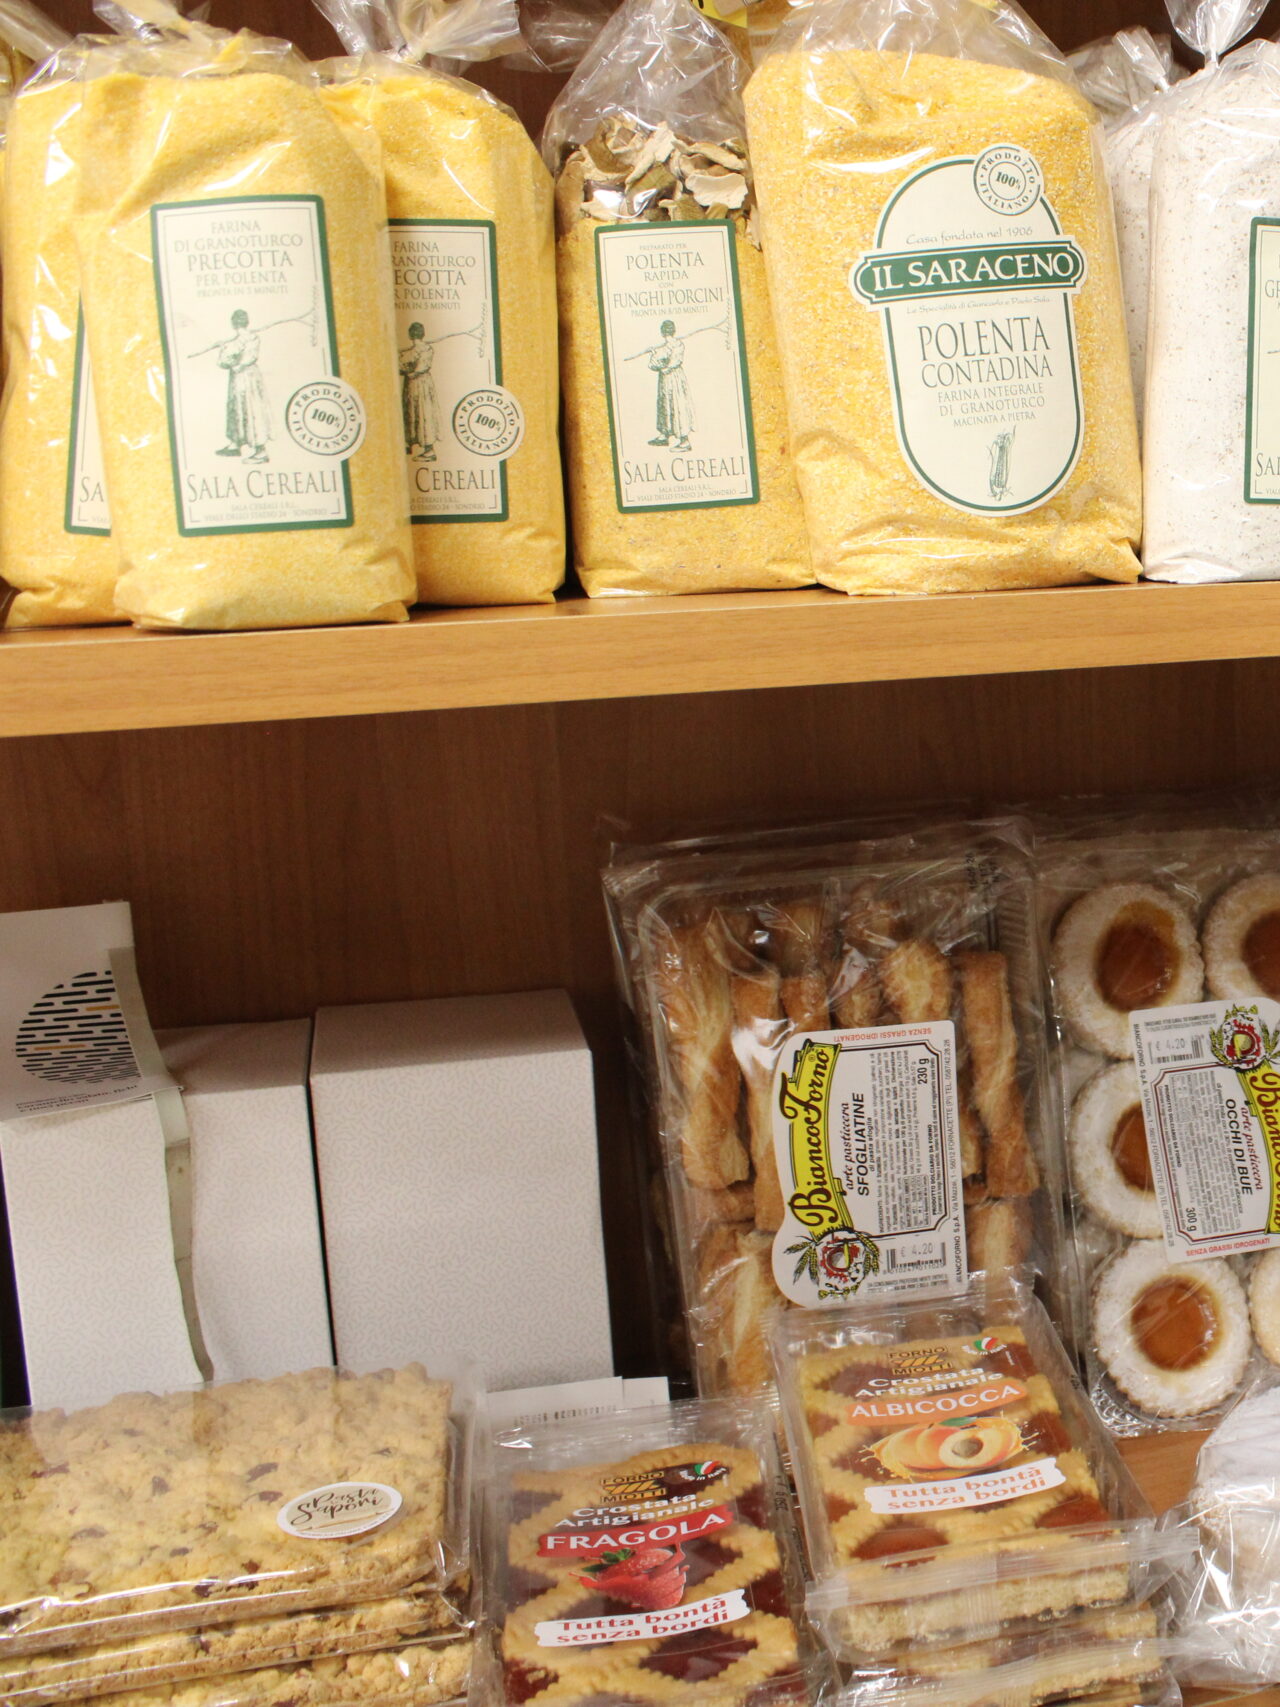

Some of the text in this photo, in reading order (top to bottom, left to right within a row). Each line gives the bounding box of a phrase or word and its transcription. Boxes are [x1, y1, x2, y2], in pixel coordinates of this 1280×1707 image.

[982, 152, 1036, 185] PRODOTTO
[995, 170, 1021, 190] 100%
[978, 182, 1031, 210] ITALIANO
[211, 219, 261, 235] FARINA
[906, 233, 938, 246] Casa
[941, 229, 985, 245] fondata
[987, 227, 1002, 238] nel
[174, 234, 303, 253] DI GRANOTURCO
[394, 240, 440, 254] FARINA
[187, 250, 293, 272] PRECOTTA
[392, 255, 476, 269] RANOTURCO
[626, 251, 705, 271] POLENTA
[871, 251, 1075, 293] IL SARACENO
[196, 270, 288, 288] PER POLENTA
[394, 269, 467, 286] ECOTTA
[643, 269, 689, 282] RAPIDA
[404, 288, 460, 301] POLENTA
[613, 287, 723, 310] FUNGHI PORCINI
[631, 305, 709, 317] PRONTA MINUTI
[918, 316, 1051, 361] POLENTA
[921, 354, 1053, 388] CONTADINA
[937, 382, 1044, 404] FARINA INTEGRALE
[294, 388, 358, 424] PRODOTTO
[461, 395, 516, 428] PRODOTTO
[939, 394, 1046, 417] DI GRANOTURCO
[309, 407, 341, 429] 100%
[474, 413, 502, 432] 100%
[953, 414, 997, 428] MACINATA
[1007, 409, 1035, 422] PIETRA
[291, 419, 350, 450] ITALIANO
[458, 421, 511, 450] ITALIANO
[415, 467, 496, 493] CEREALI
[624, 455, 746, 486] SALA CEREALI
[79, 476, 104, 504] SA
[187, 468, 338, 503] SALA CEREALI
[833, 1027, 932, 1043] SENZA GRASSI IDROGENATI
[917, 1057, 930, 1085] 230 g
[1240, 1106, 1249, 1128] arte
[851, 1092, 870, 1197] SFOGLIATINE
[1225, 1098, 1253, 1195] OCCHI DI BUE
[844, 1172, 854, 1191] arte
[1185, 1206, 1197, 1232] 300 g
[1185, 1237, 1271, 1257] SENZA GRASSI IDROGENATI
[889, 1346, 947, 1359] FORNO
[868, 1366, 984, 1388] Crostata
[893, 1362, 952, 1375] MIOTTI
[855, 1372, 1003, 1398] Artigianale
[851, 1385, 1020, 1418] ALBICOCCA
[603, 1471, 663, 1485] FORNO
[885, 1466, 1042, 1498] Tutta bontà
[573, 1493, 697, 1518] Crostata
[604, 1488, 666, 1503] MIOTTI
[887, 1478, 1047, 1510] senza bordi
[290, 1496, 383, 1526] Sapori
[555, 1498, 716, 1528] Artigianale
[546, 1513, 726, 1550] FRAGOLA
[558, 1597, 726, 1631] Tutta bontà
[556, 1609, 728, 1643] senza bordi
